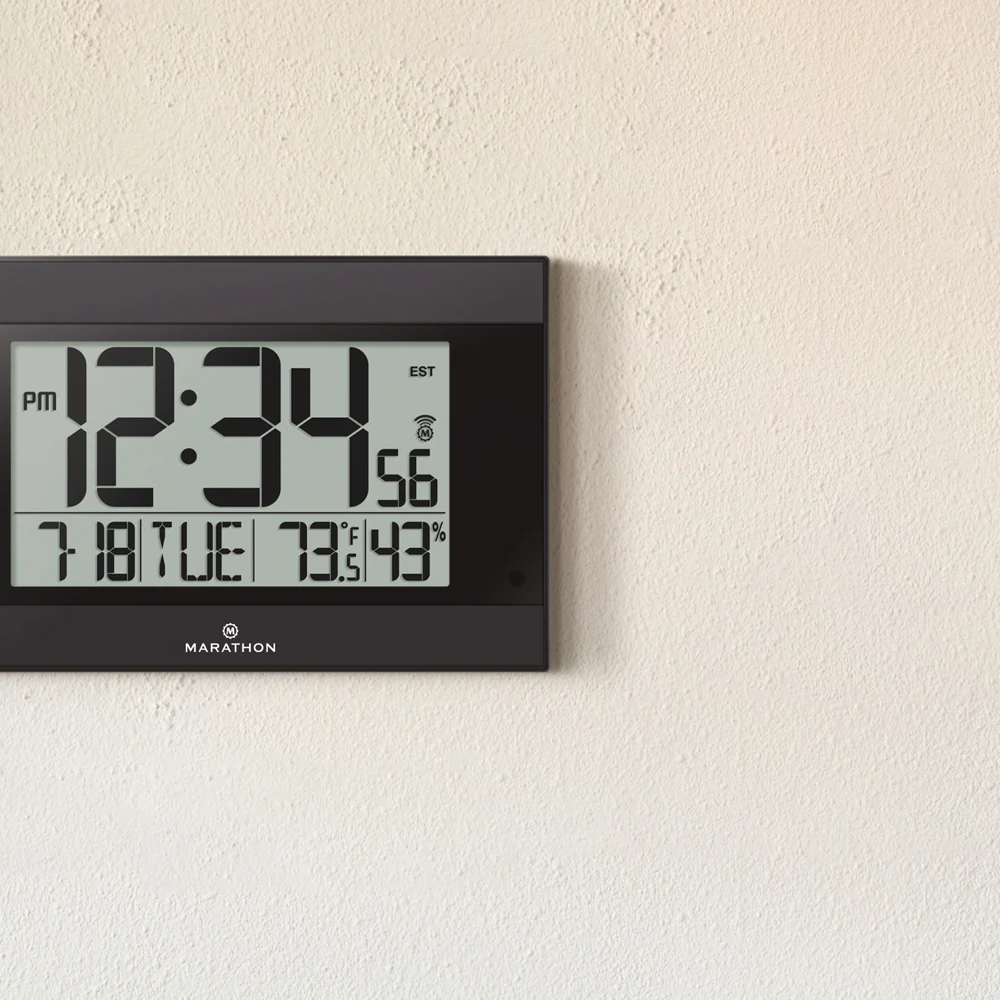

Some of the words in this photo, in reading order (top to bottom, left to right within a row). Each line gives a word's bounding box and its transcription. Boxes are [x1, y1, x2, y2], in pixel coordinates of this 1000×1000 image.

[410, 366, 435, 377] EST
[23, 391, 57, 411] PM
[67, 346, 369, 508] 12:34
[377, 449, 438, 508] 56
[152, 521, 245, 582] TUE
[185, 642, 276, 653] MARATHON
